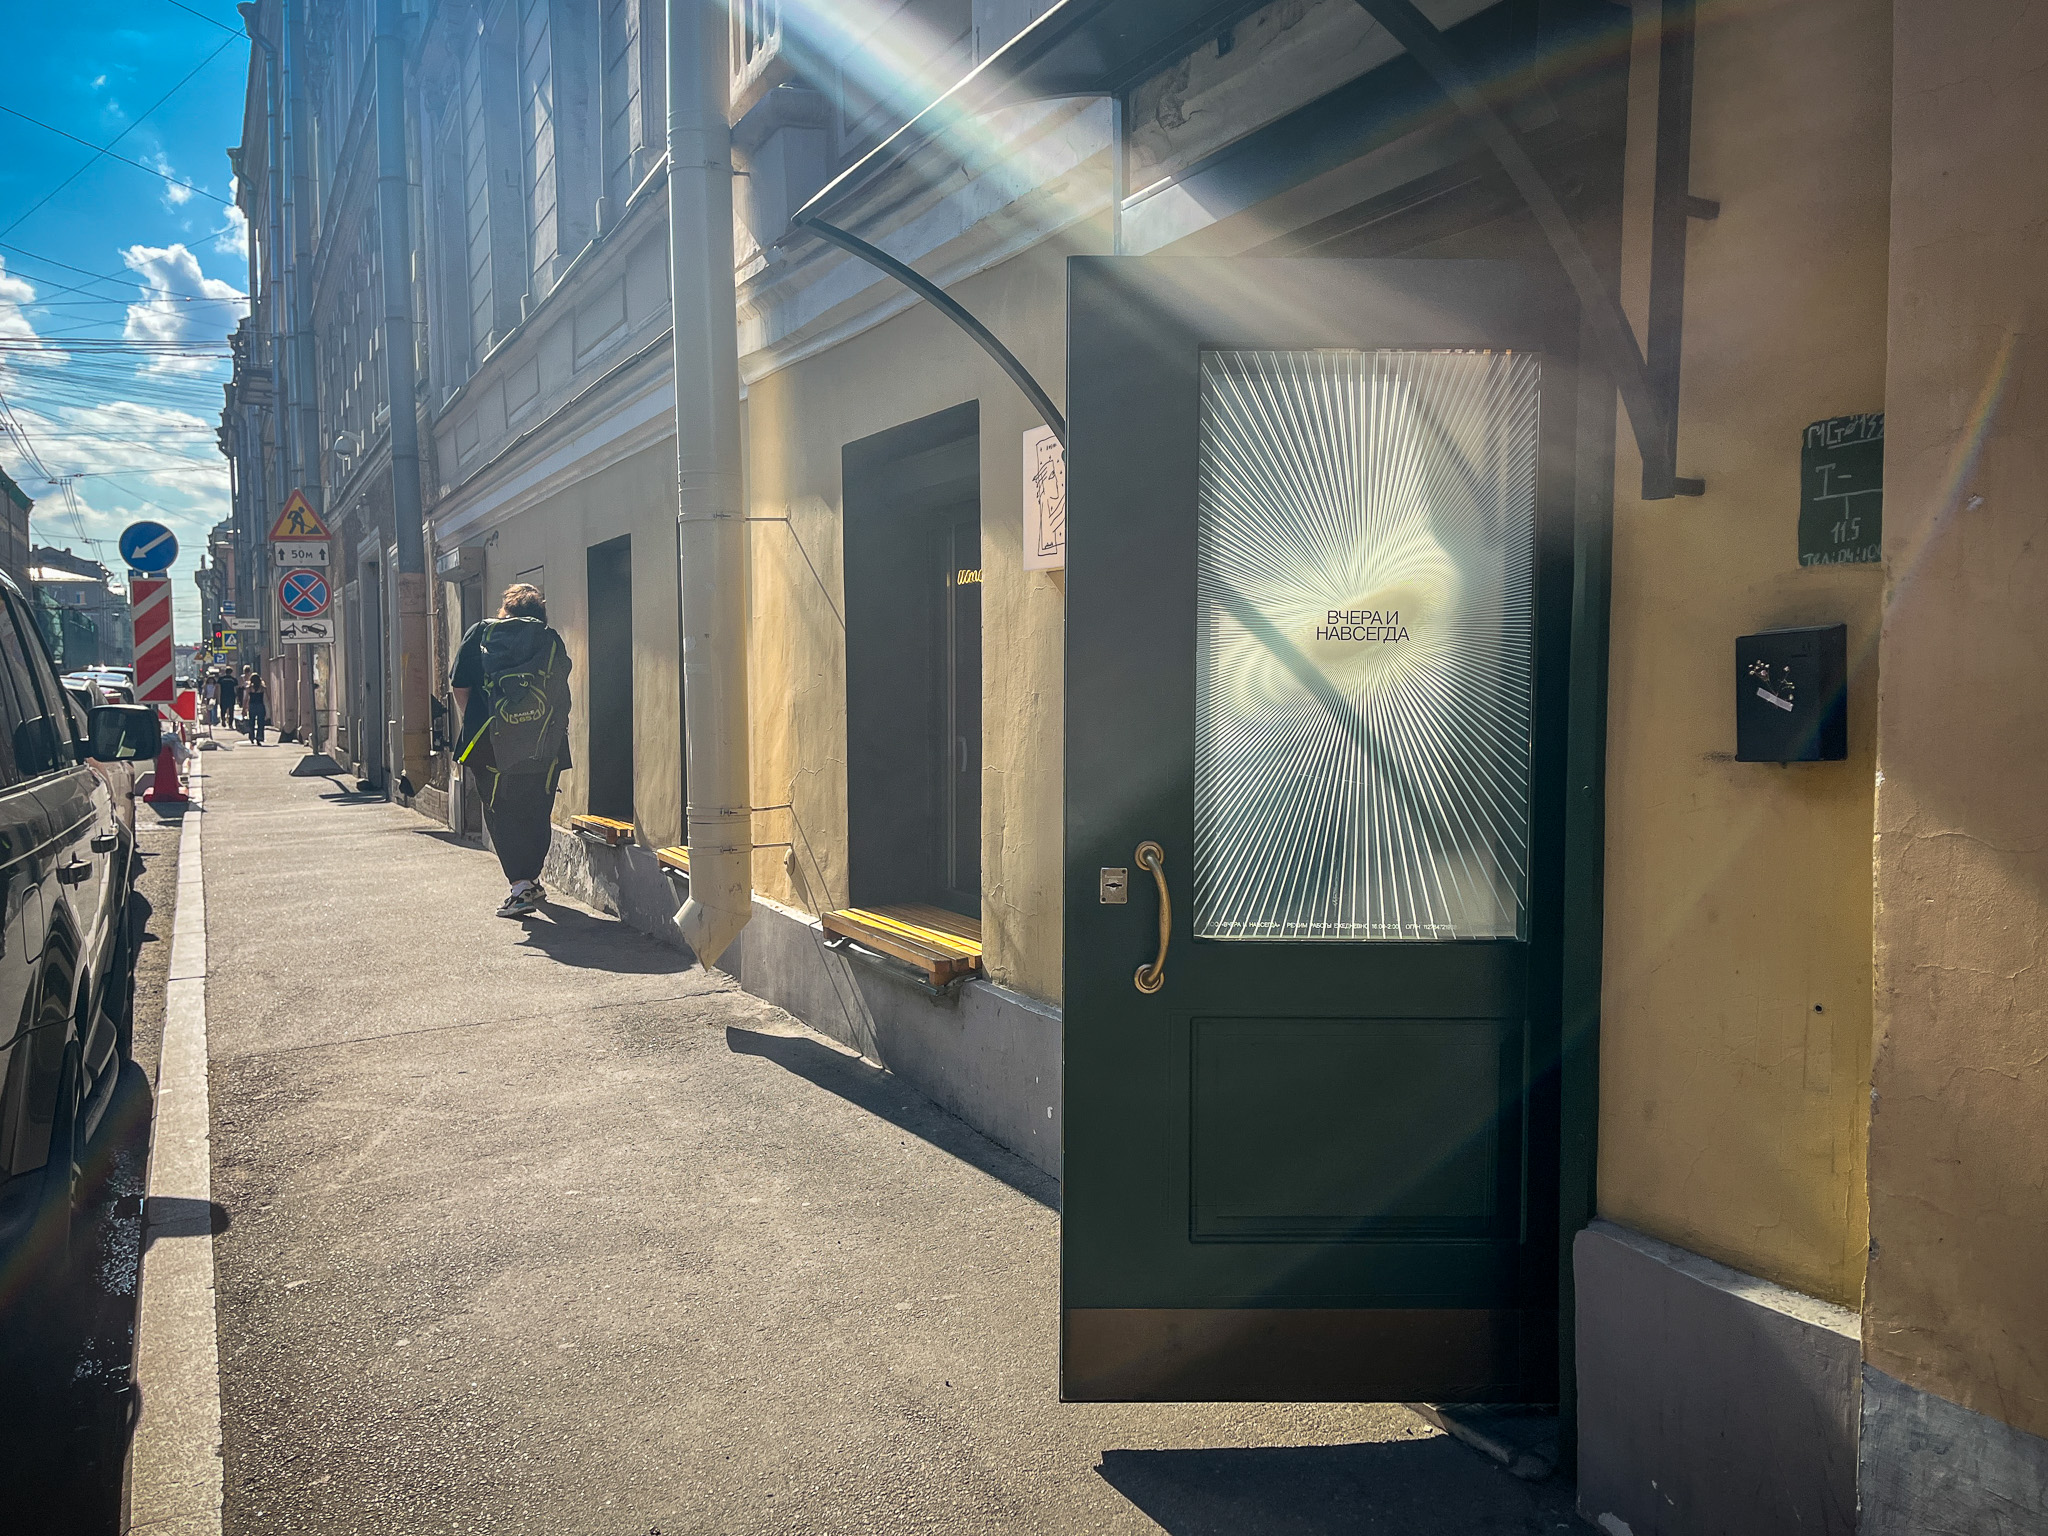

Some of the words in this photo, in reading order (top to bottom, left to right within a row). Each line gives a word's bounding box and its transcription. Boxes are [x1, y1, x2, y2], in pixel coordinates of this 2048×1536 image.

[291, 550, 313, 559] 50м
[1327, 610, 1383, 625] ВЧЕРА
[1386, 610, 1399, 625] И
[1316, 626, 1410, 643] НАВСЕГДА
